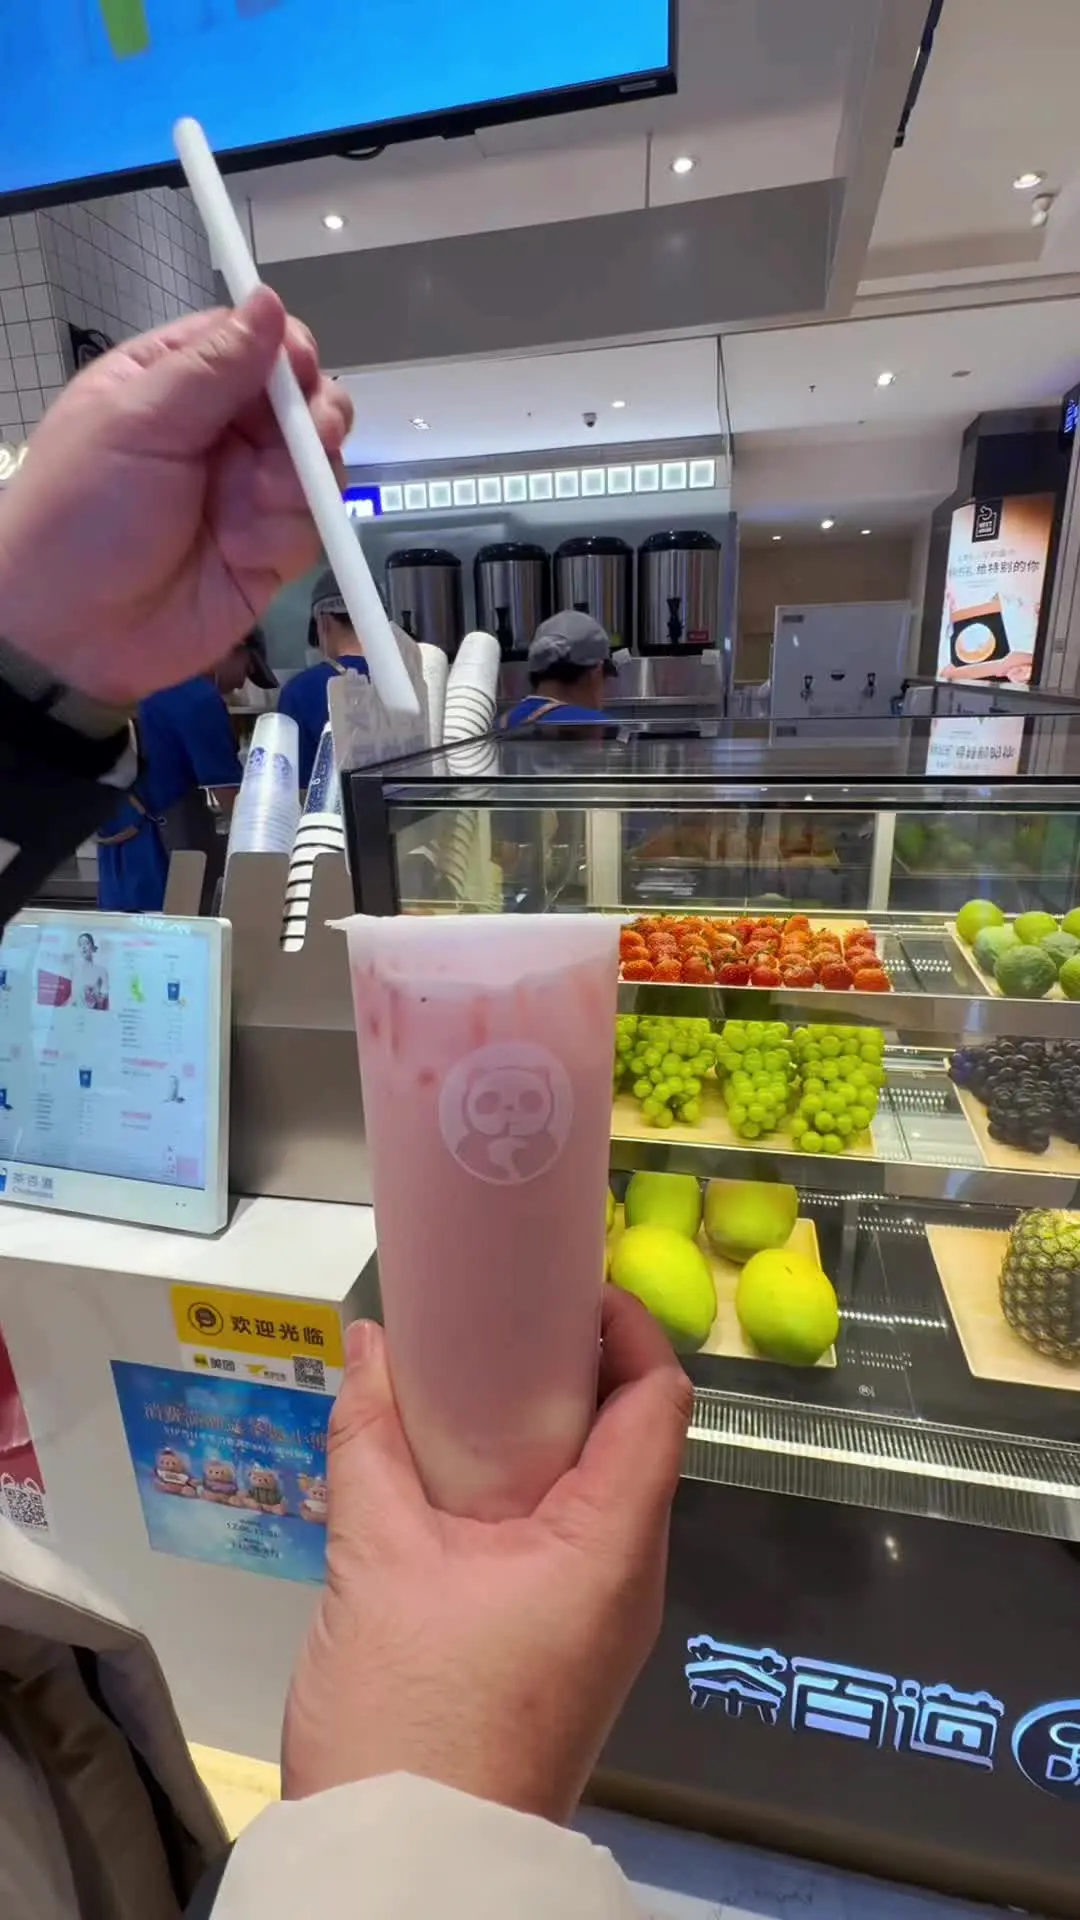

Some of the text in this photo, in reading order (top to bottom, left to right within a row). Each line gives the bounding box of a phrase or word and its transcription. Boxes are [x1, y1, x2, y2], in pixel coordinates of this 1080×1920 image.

[231, 1315, 325, 1347] 欢迎光临
[685, 1634, 1005, 1773] 茶百道
